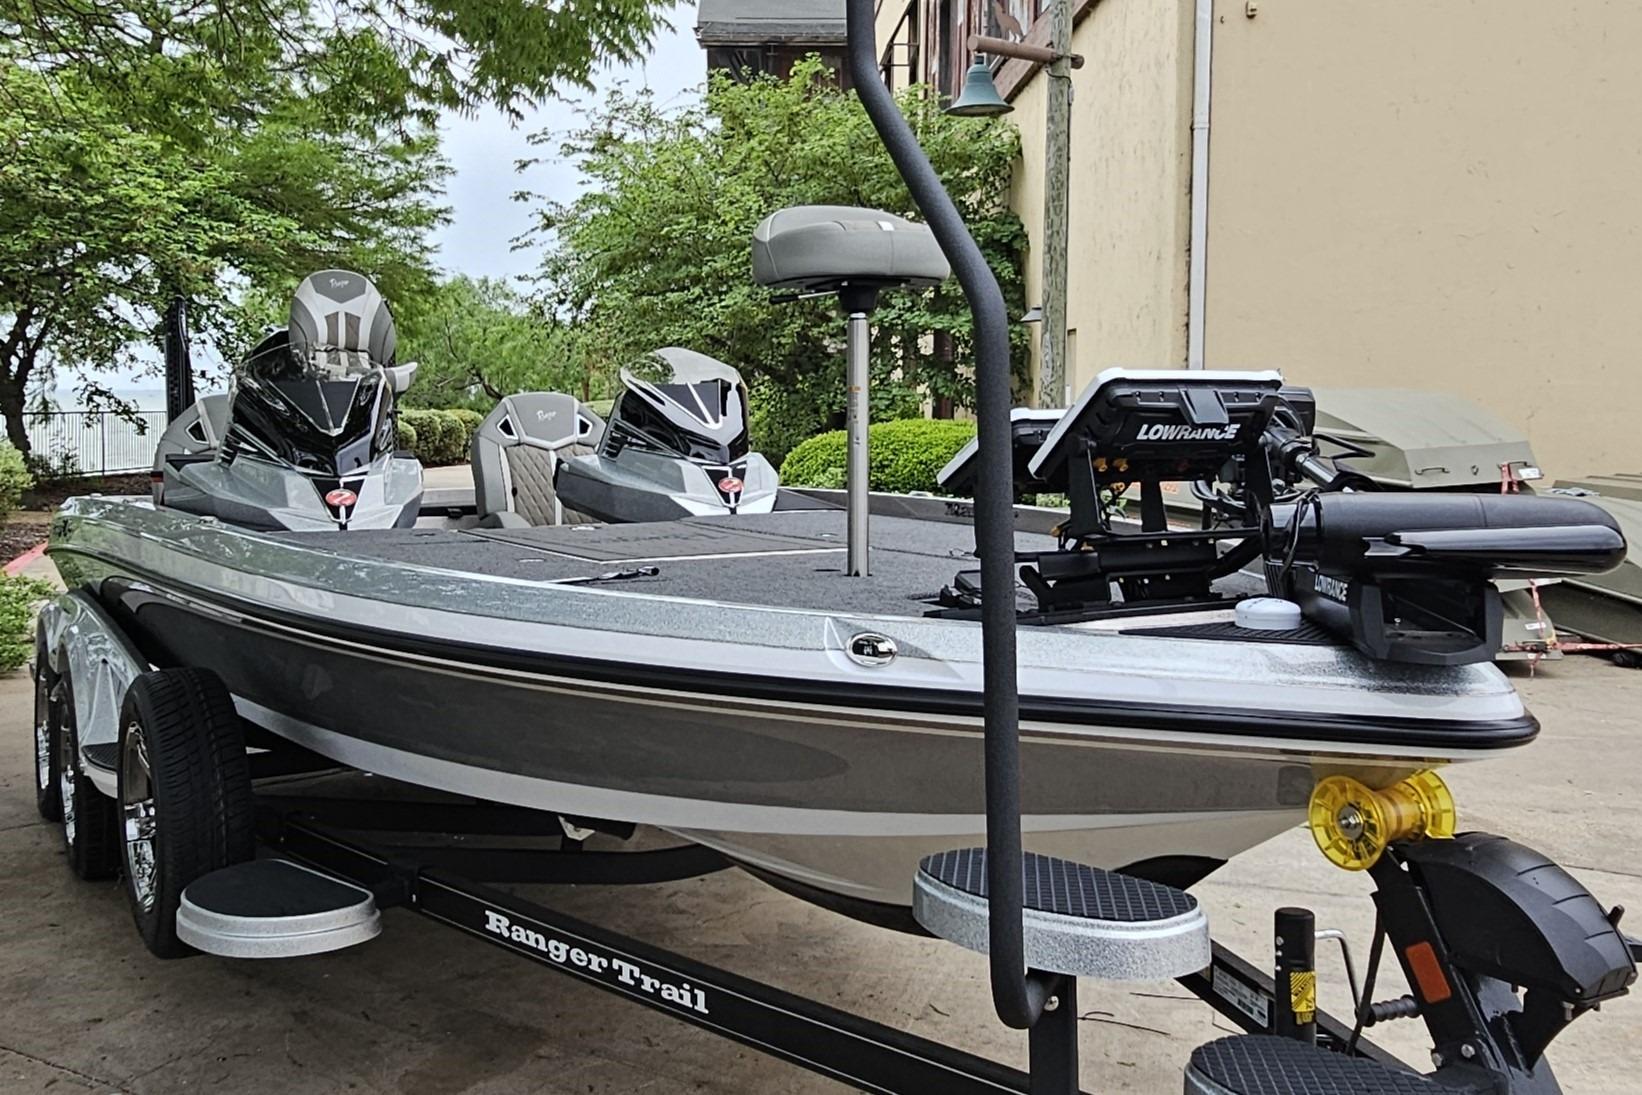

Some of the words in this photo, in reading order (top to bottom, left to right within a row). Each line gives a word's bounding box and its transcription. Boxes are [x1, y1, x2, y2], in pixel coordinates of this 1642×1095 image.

[1136, 423, 1241, 440] LOWRANCE
[485, 910, 608, 973] Ranger
[612, 958, 709, 1014] Trail
